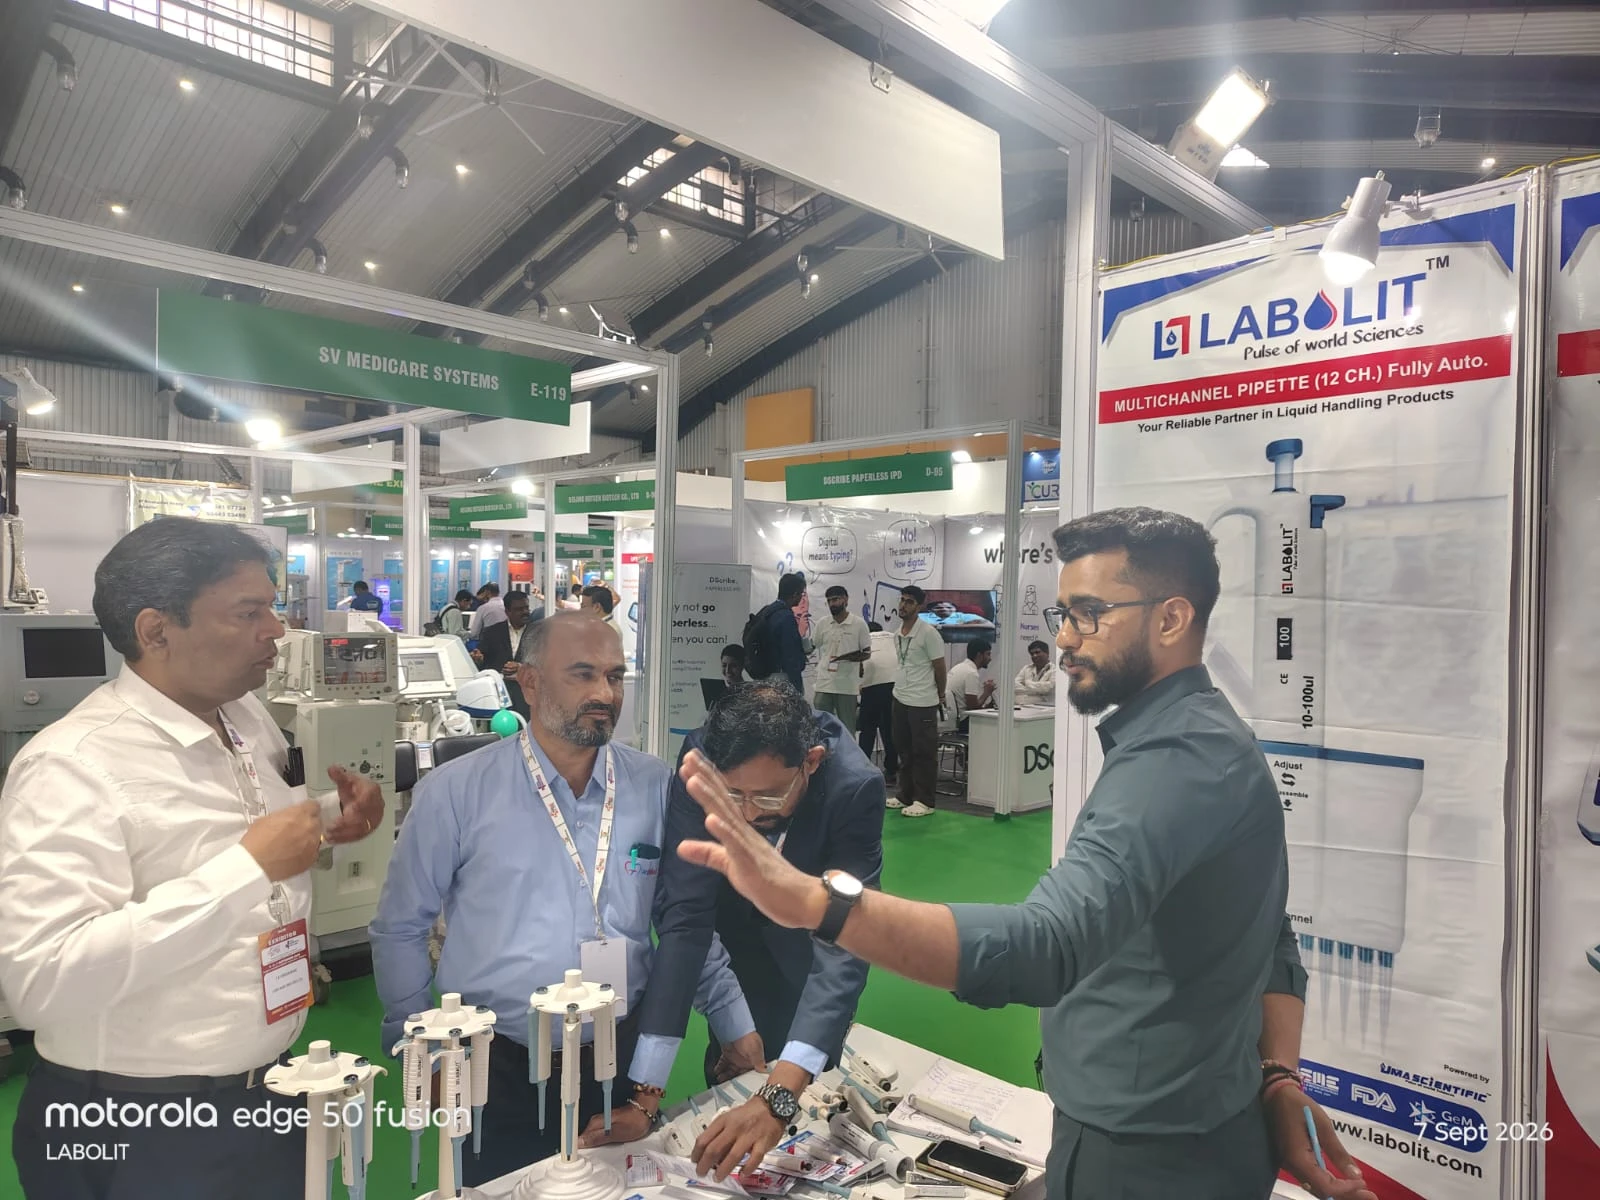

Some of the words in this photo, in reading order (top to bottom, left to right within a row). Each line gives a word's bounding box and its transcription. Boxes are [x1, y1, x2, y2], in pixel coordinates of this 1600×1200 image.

[1425, 255, 1450, 272] TM
[1200, 273, 1427, 348] LABOLIT
[1243, 346, 1281, 361] Pulse
[1284, 341, 1300, 354] of
[1305, 335, 1348, 351] world
[1353, 322, 1425, 344] Sciences
[319, 346, 342, 365] SV
[347, 350, 429, 379] MEDICARE
[433, 366, 500, 390] SYSTEMS
[530, 382, 567, 401] E-119
[1114, 384, 1233, 413] MULTICHANNEL
[1237, 374, 1310, 397] PIPETTE
[1314, 371, 1341, 391] (12
[1345, 365, 1383, 387] CH.)
[1388, 359, 1433, 379] Fully
[1438, 352, 1489, 372] Auto.
[1138, 422, 1163, 434] Your
[1165, 416, 1212, 431] Reliable
[1215, 411, 1259, 426] Partner
[1262, 408, 1273, 420] in
[1277, 403, 1317, 419] Liquid
[1322, 397, 1383, 414] Handling
[1387, 388, 1455, 407] Products
[824, 476, 850, 485] DSCRIBE
[852, 473, 889, 483] PAPERLESS
[891, 470, 903, 480] IPD
[818, 536, 838, 549] Digital
[900, 527, 917, 543] No!
[808, 553, 829, 561] means
[830, 550, 853, 562] typing?
[984, 542, 1053, 563] whre's
[1281, 528, 1293, 581] LABOLIT
[683, 602, 699, 613] not
[702, 604, 716, 613] go
[686, 637, 704, 645] you
[706, 635, 728, 645] can!
[1279, 627, 1290, 648] 100
[1281, 674, 1289, 685] CE
[1302, 676, 1315, 731] 10-100ul
[1273, 760, 1303, 770] Adjust
[1444, 1064, 1479, 1080] Powered
[1480, 1075, 1491, 1084] by
[1351, 1083, 1397, 1113] FDA
